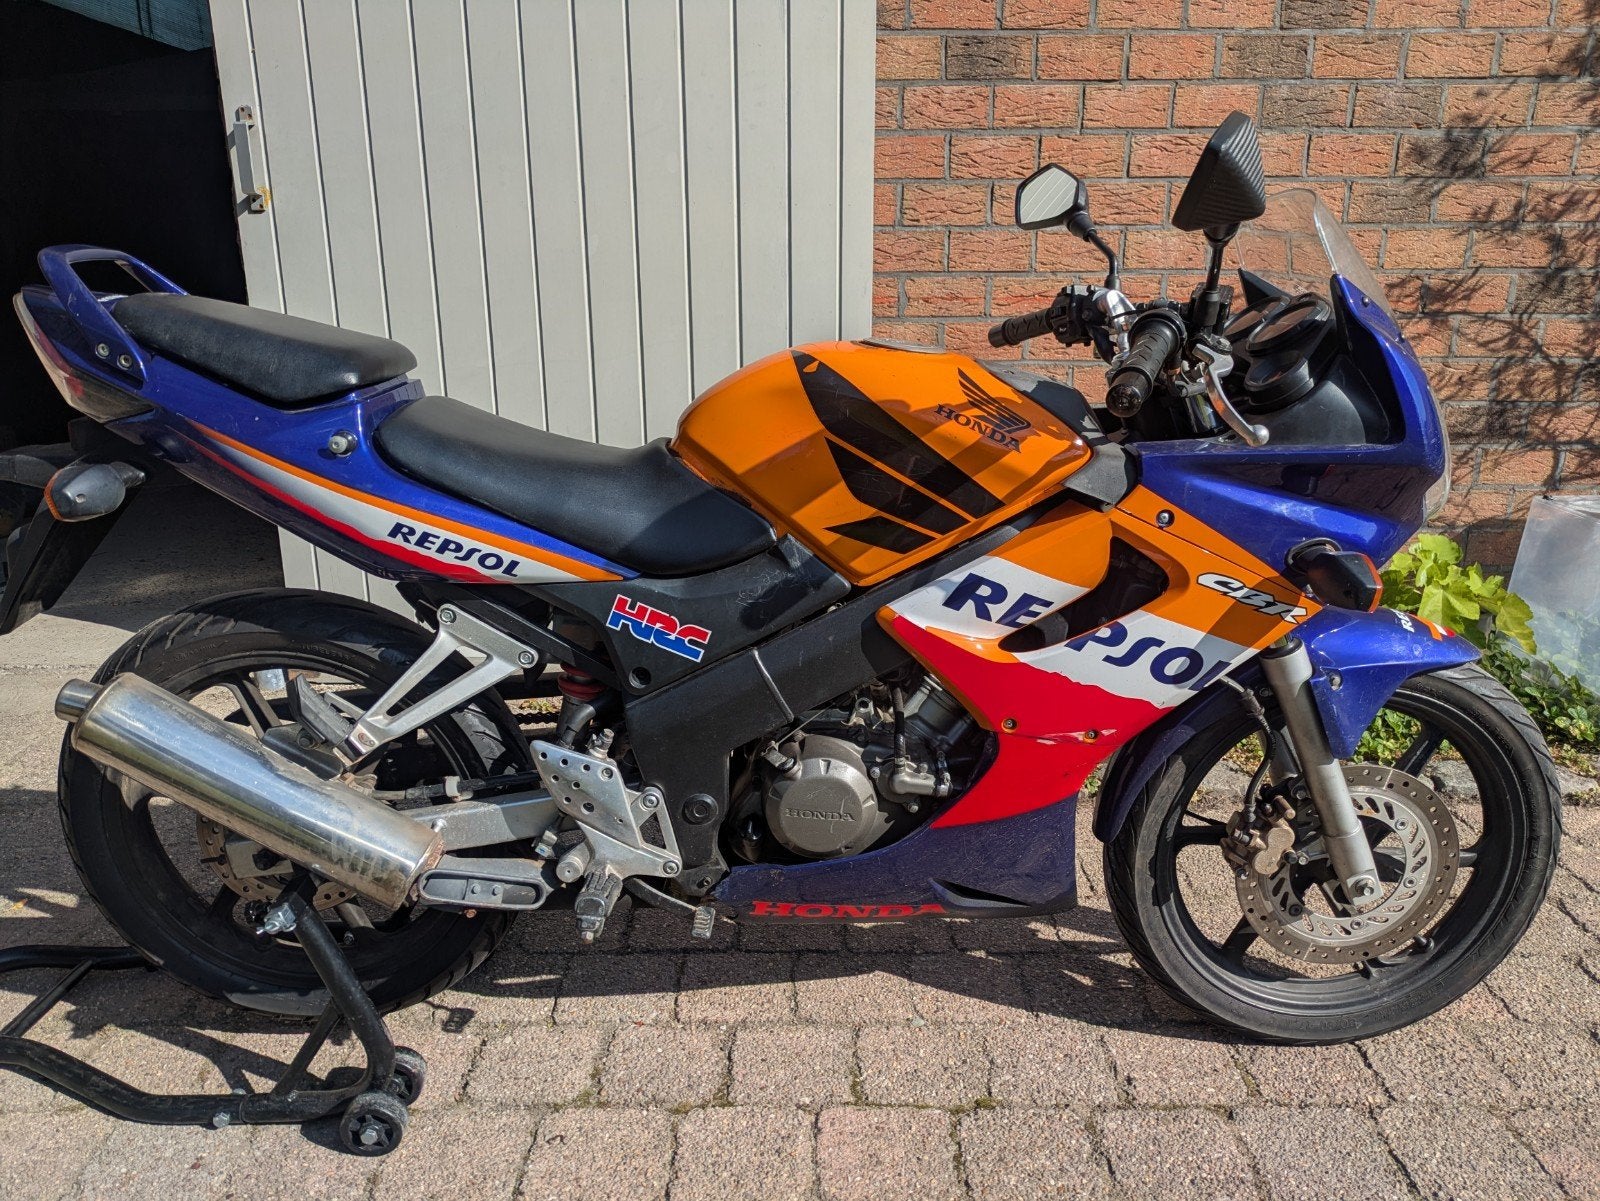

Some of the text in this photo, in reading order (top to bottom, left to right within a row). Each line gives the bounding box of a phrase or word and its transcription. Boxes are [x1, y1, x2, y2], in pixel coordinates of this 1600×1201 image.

[934, 403, 1021, 453] HONDA
[388, 522, 521, 578] REPSOL
[606, 594, 712, 663] HRC
[785, 808, 856, 822] HONDA
[750, 901, 947, 918] HONDA
